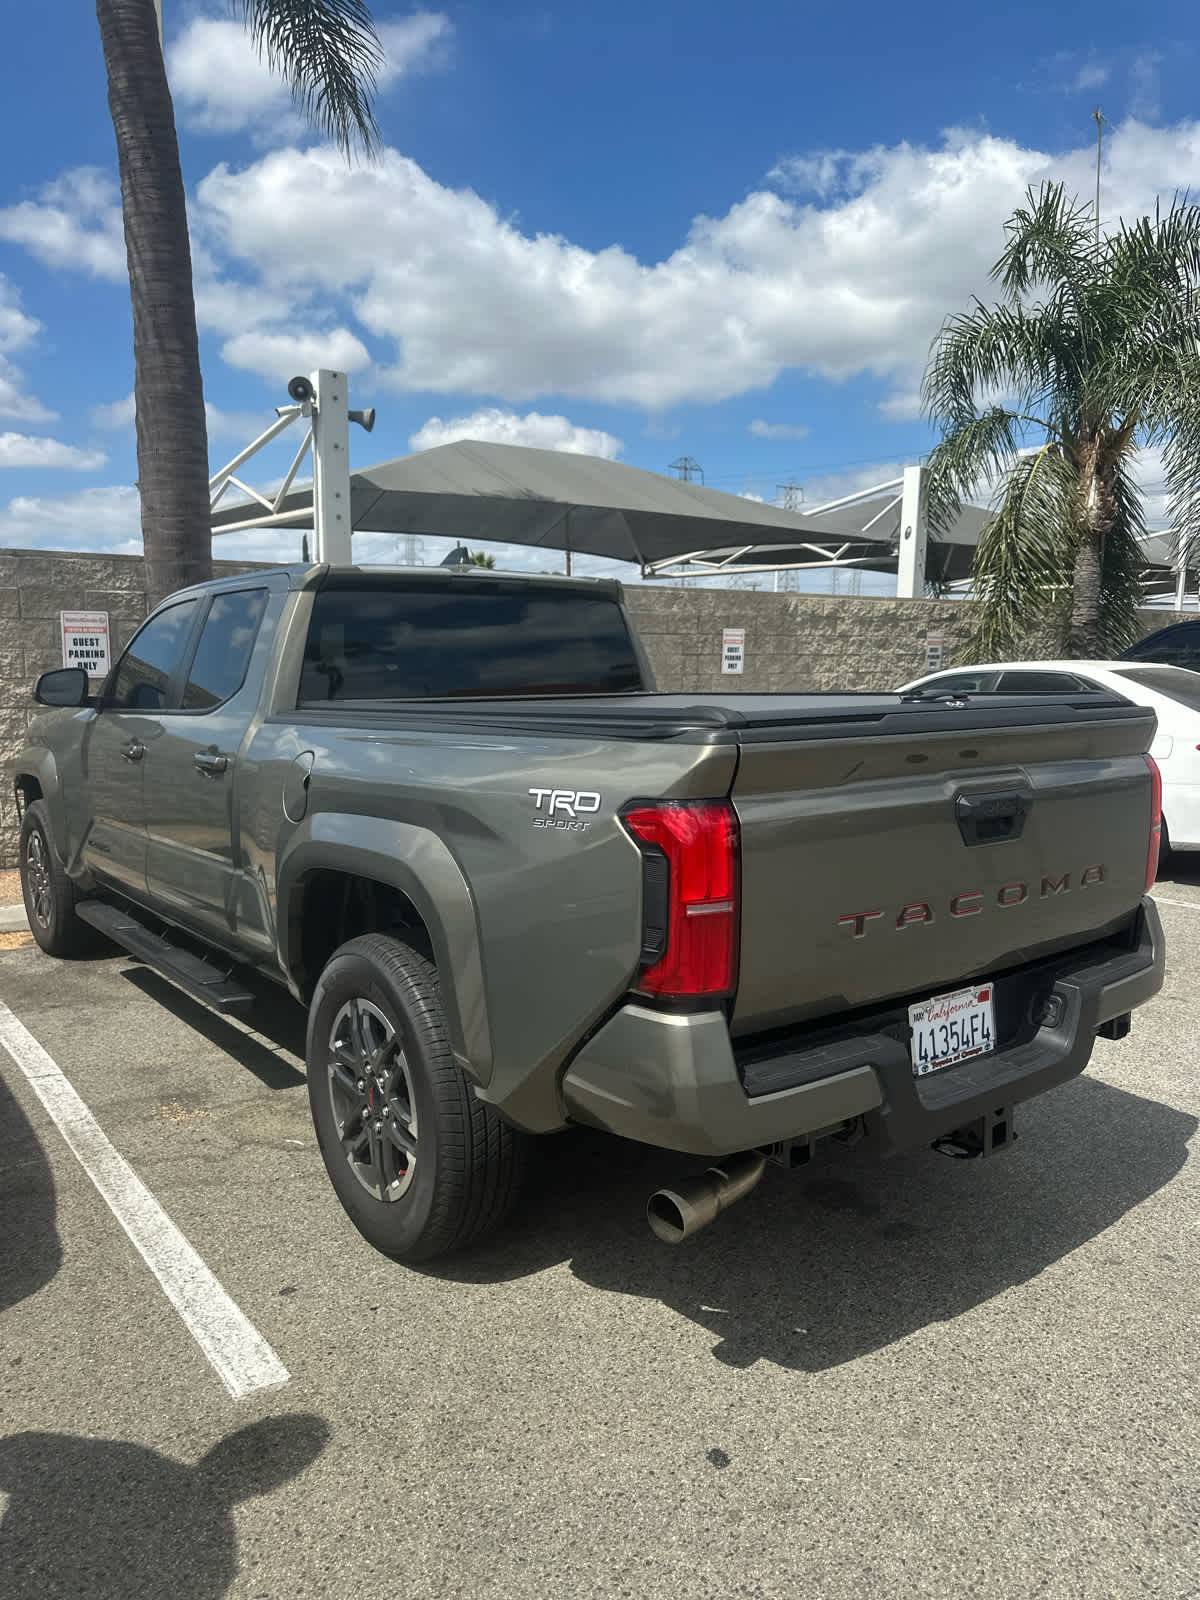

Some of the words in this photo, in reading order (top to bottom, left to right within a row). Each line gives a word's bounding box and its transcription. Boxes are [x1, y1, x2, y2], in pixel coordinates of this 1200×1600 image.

[72, 638, 99, 647] GUEST
[68, 649, 105, 658] PARKING
[77, 661, 97, 670] ONLY
[528, 788, 601, 818] TRD
[532, 817, 591, 832] SPORT
[837, 863, 1106, 939] TACOMA
[913, 1010, 925, 1023] MAY
[927, 999, 979, 1022] California
[918, 1011, 991, 1063] 41354F4
